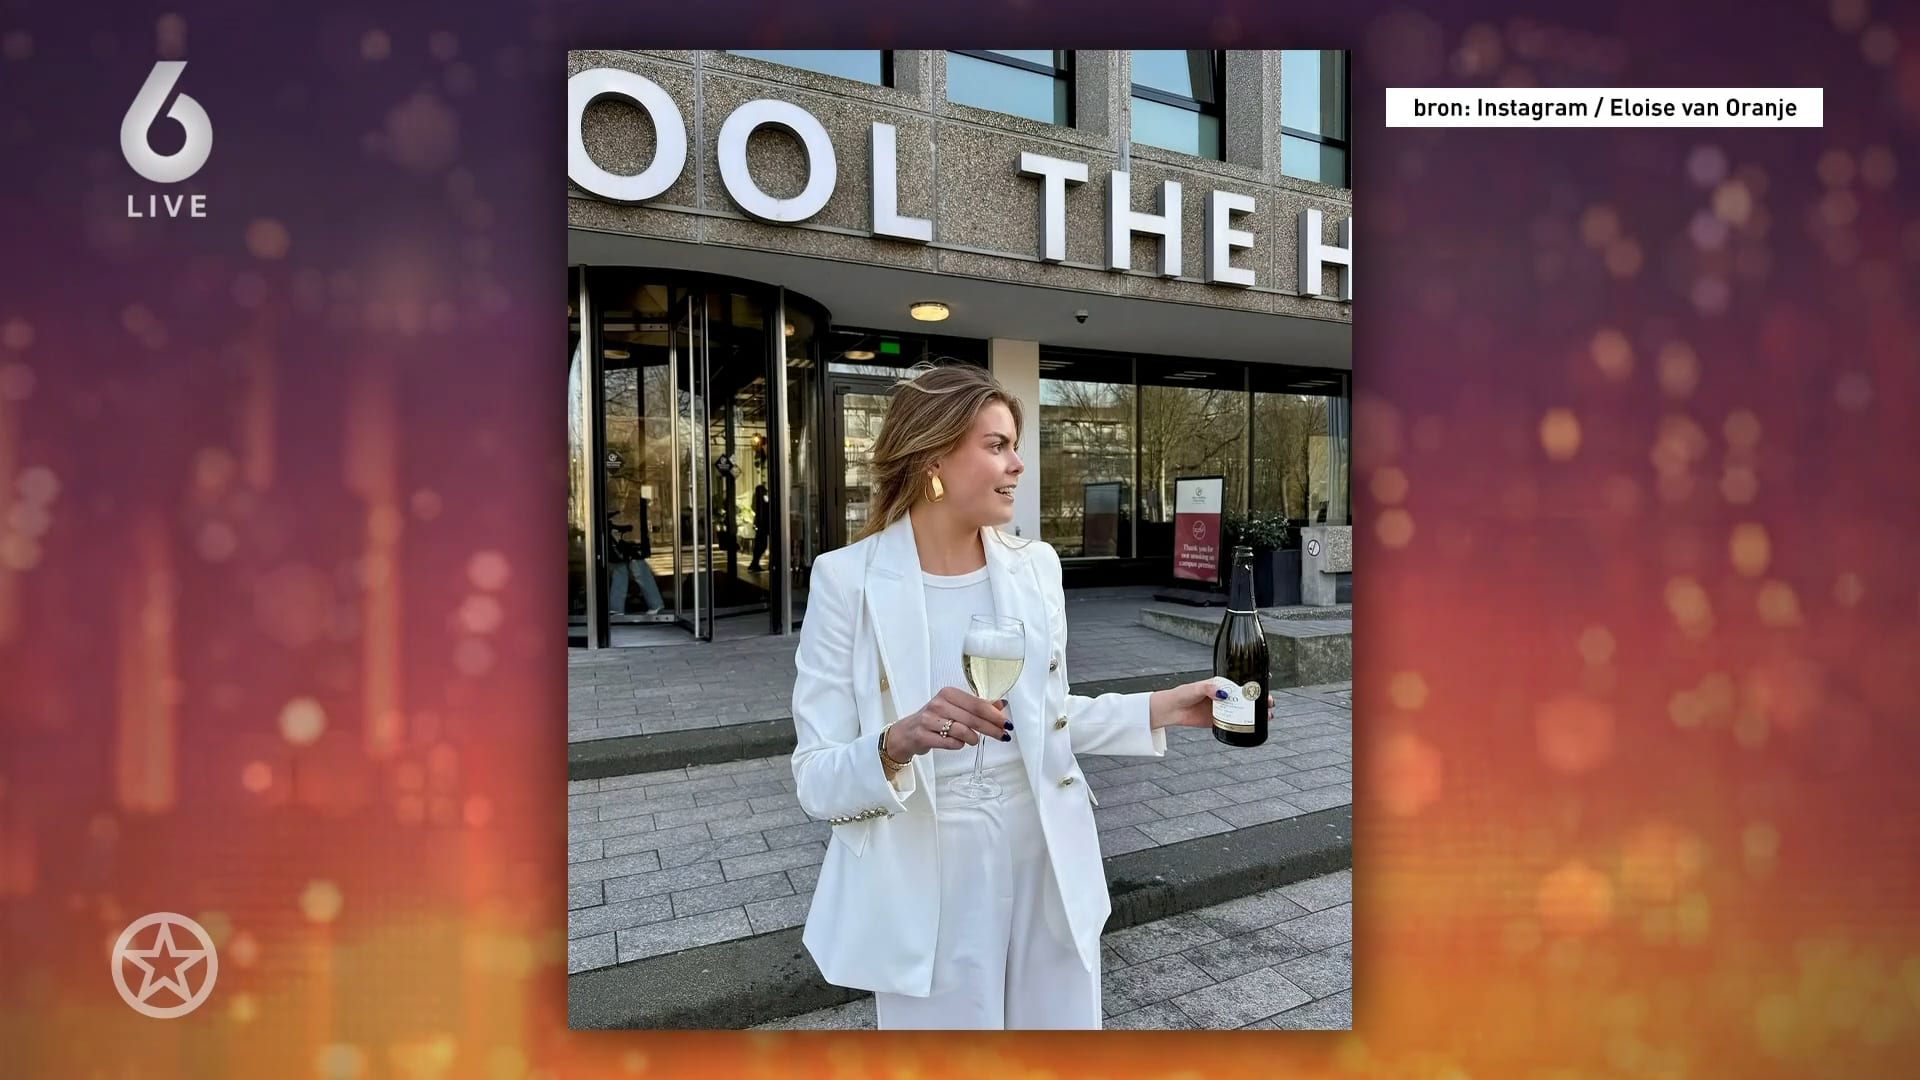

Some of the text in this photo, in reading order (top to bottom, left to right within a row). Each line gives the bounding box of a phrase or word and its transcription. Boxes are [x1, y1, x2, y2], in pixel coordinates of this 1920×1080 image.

[568, 68, 1352, 301] OOL THE H
